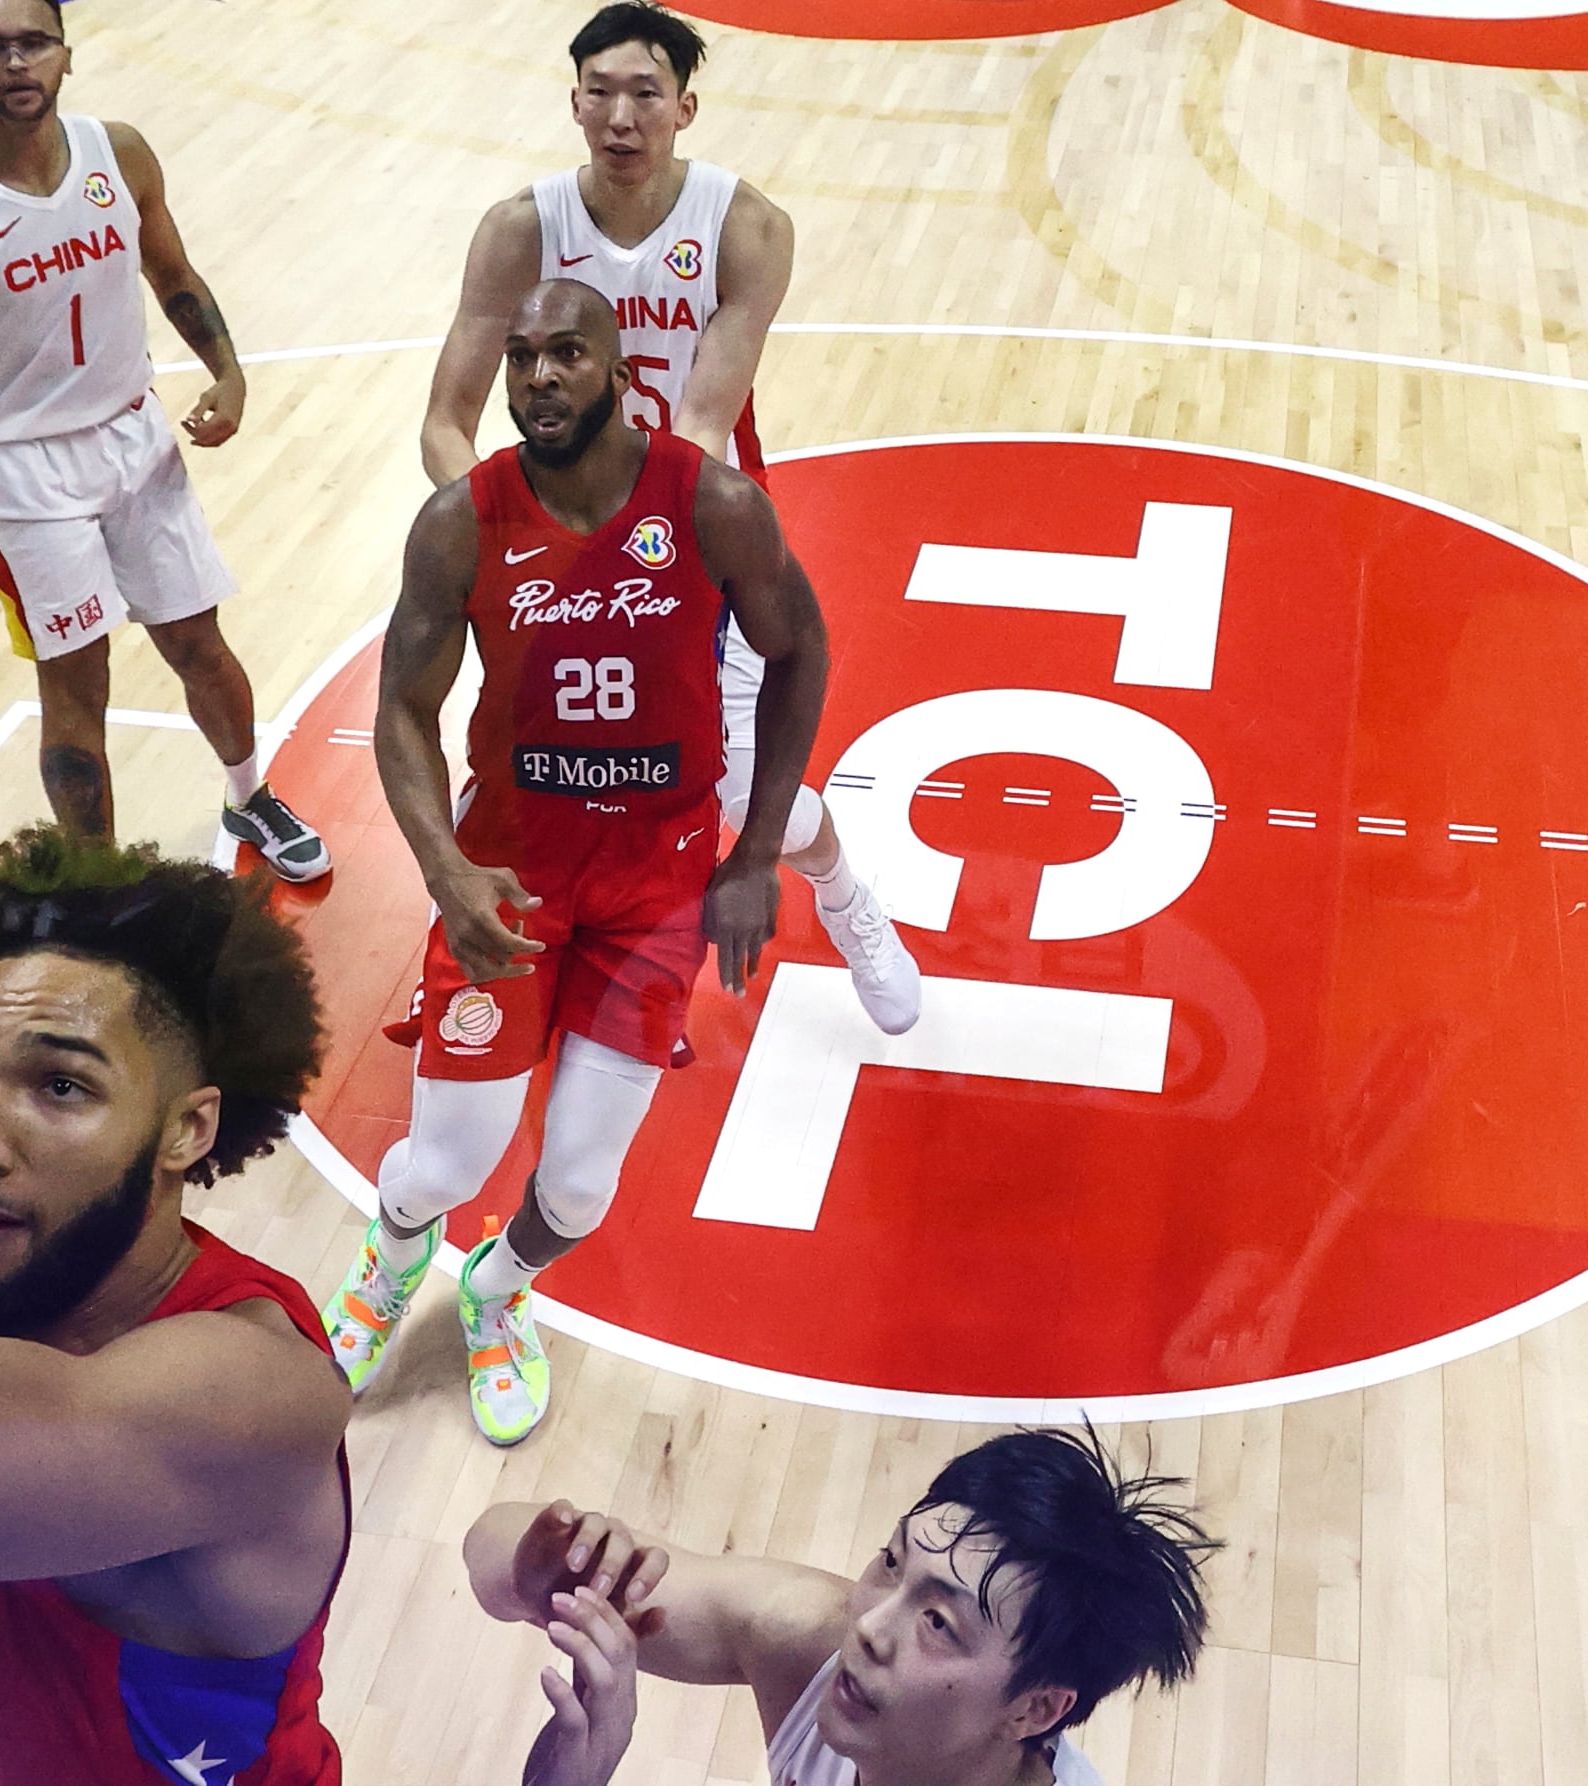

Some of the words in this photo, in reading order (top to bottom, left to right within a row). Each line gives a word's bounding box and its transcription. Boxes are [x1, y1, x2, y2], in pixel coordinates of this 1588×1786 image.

[3, 223, 126, 293] CHINA
[69, 293, 86, 366] 1
[615, 295, 698, 331] HINA
[45, 593, 103, 640] 中国
[509, 579, 603, 631] Puerto
[607, 578, 681, 628] Rico
[554, 656, 636, 721] 28
[556, 755, 670, 788] Mobile
[692, 502, 1232, 1231] TCL
